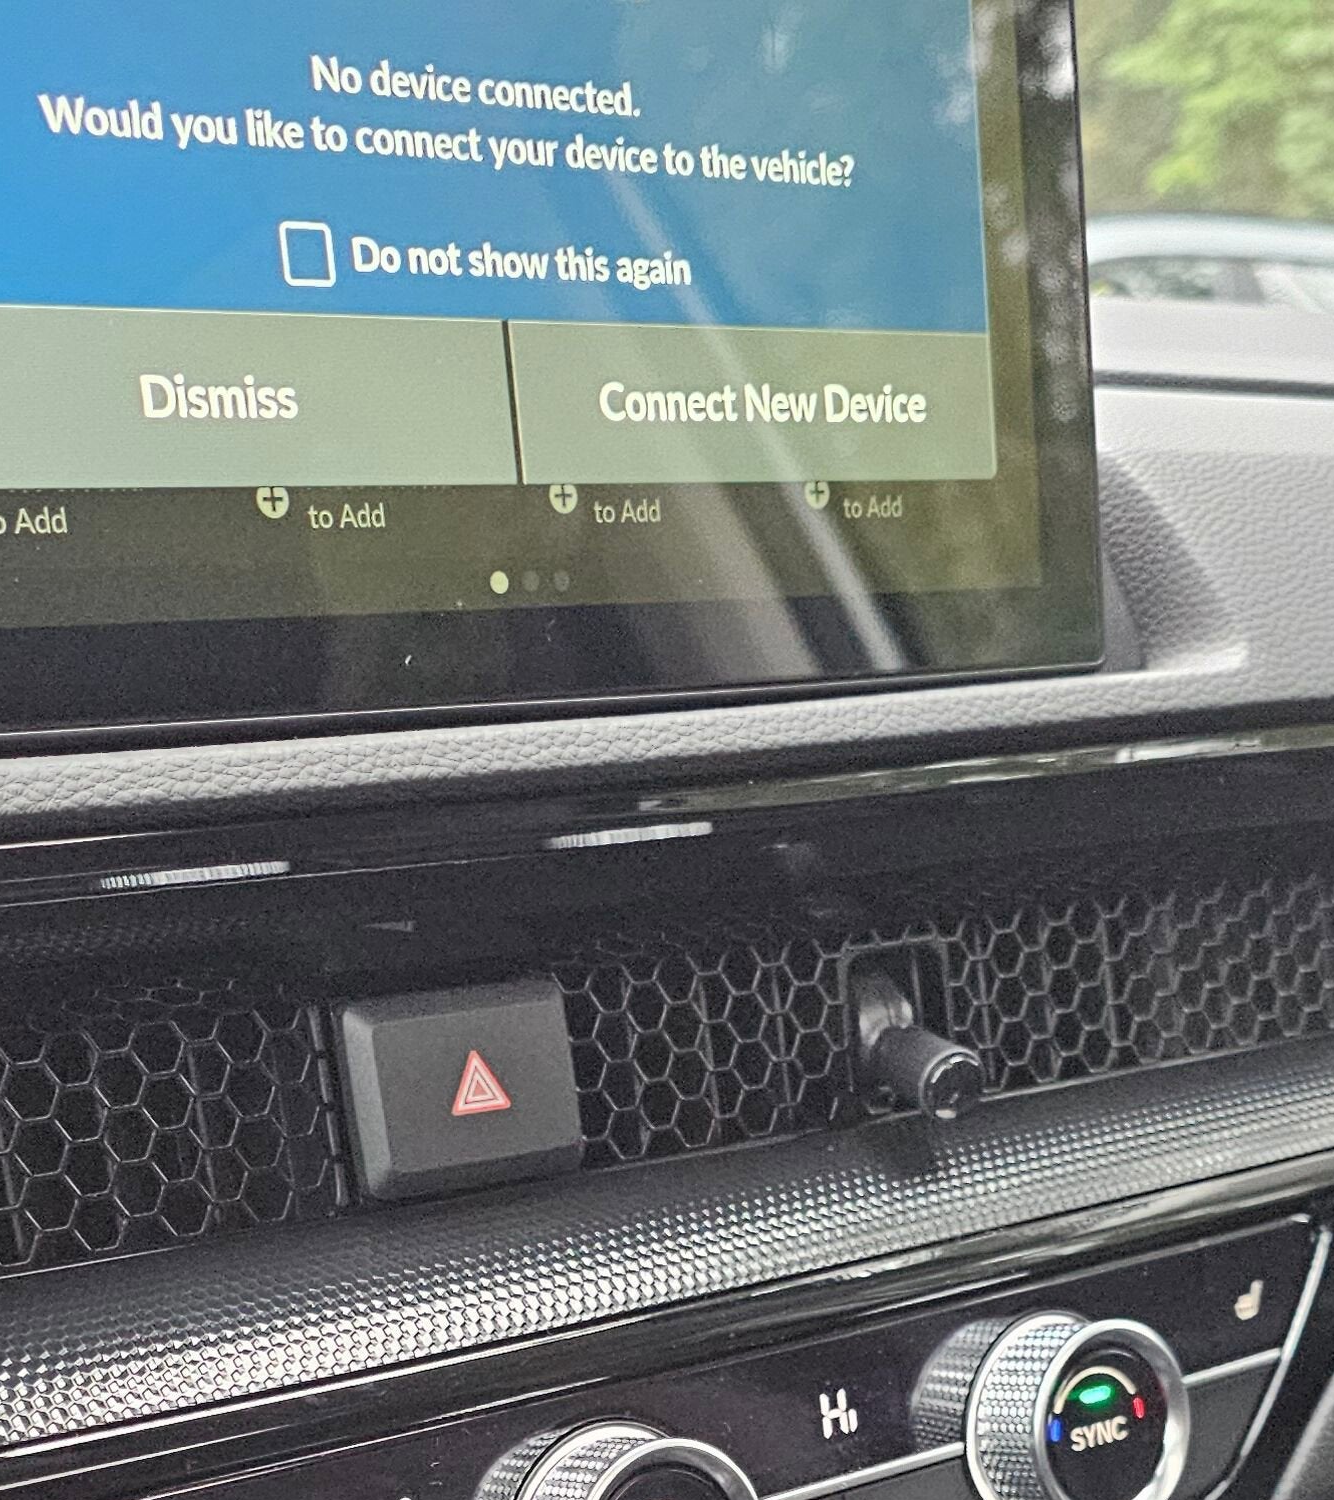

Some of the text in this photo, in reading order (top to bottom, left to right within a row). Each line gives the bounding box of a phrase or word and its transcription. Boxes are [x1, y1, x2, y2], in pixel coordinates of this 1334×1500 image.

[310, 54, 641, 118] No device connected.
[37, 93, 856, 189] Would you like to connect your device to the vehicle?
[351, 235, 693, 291] Do not show this again
[139, 373, 300, 420] Dismiss
[599, 380, 928, 424] Connect New Device
[13, 505, 69, 536] Add
[307, 501, 387, 530] to Add
[593, 498, 662, 524] to Add
[843, 495, 904, 519] to Add
[1070, 1414, 1130, 1453] SYNC
